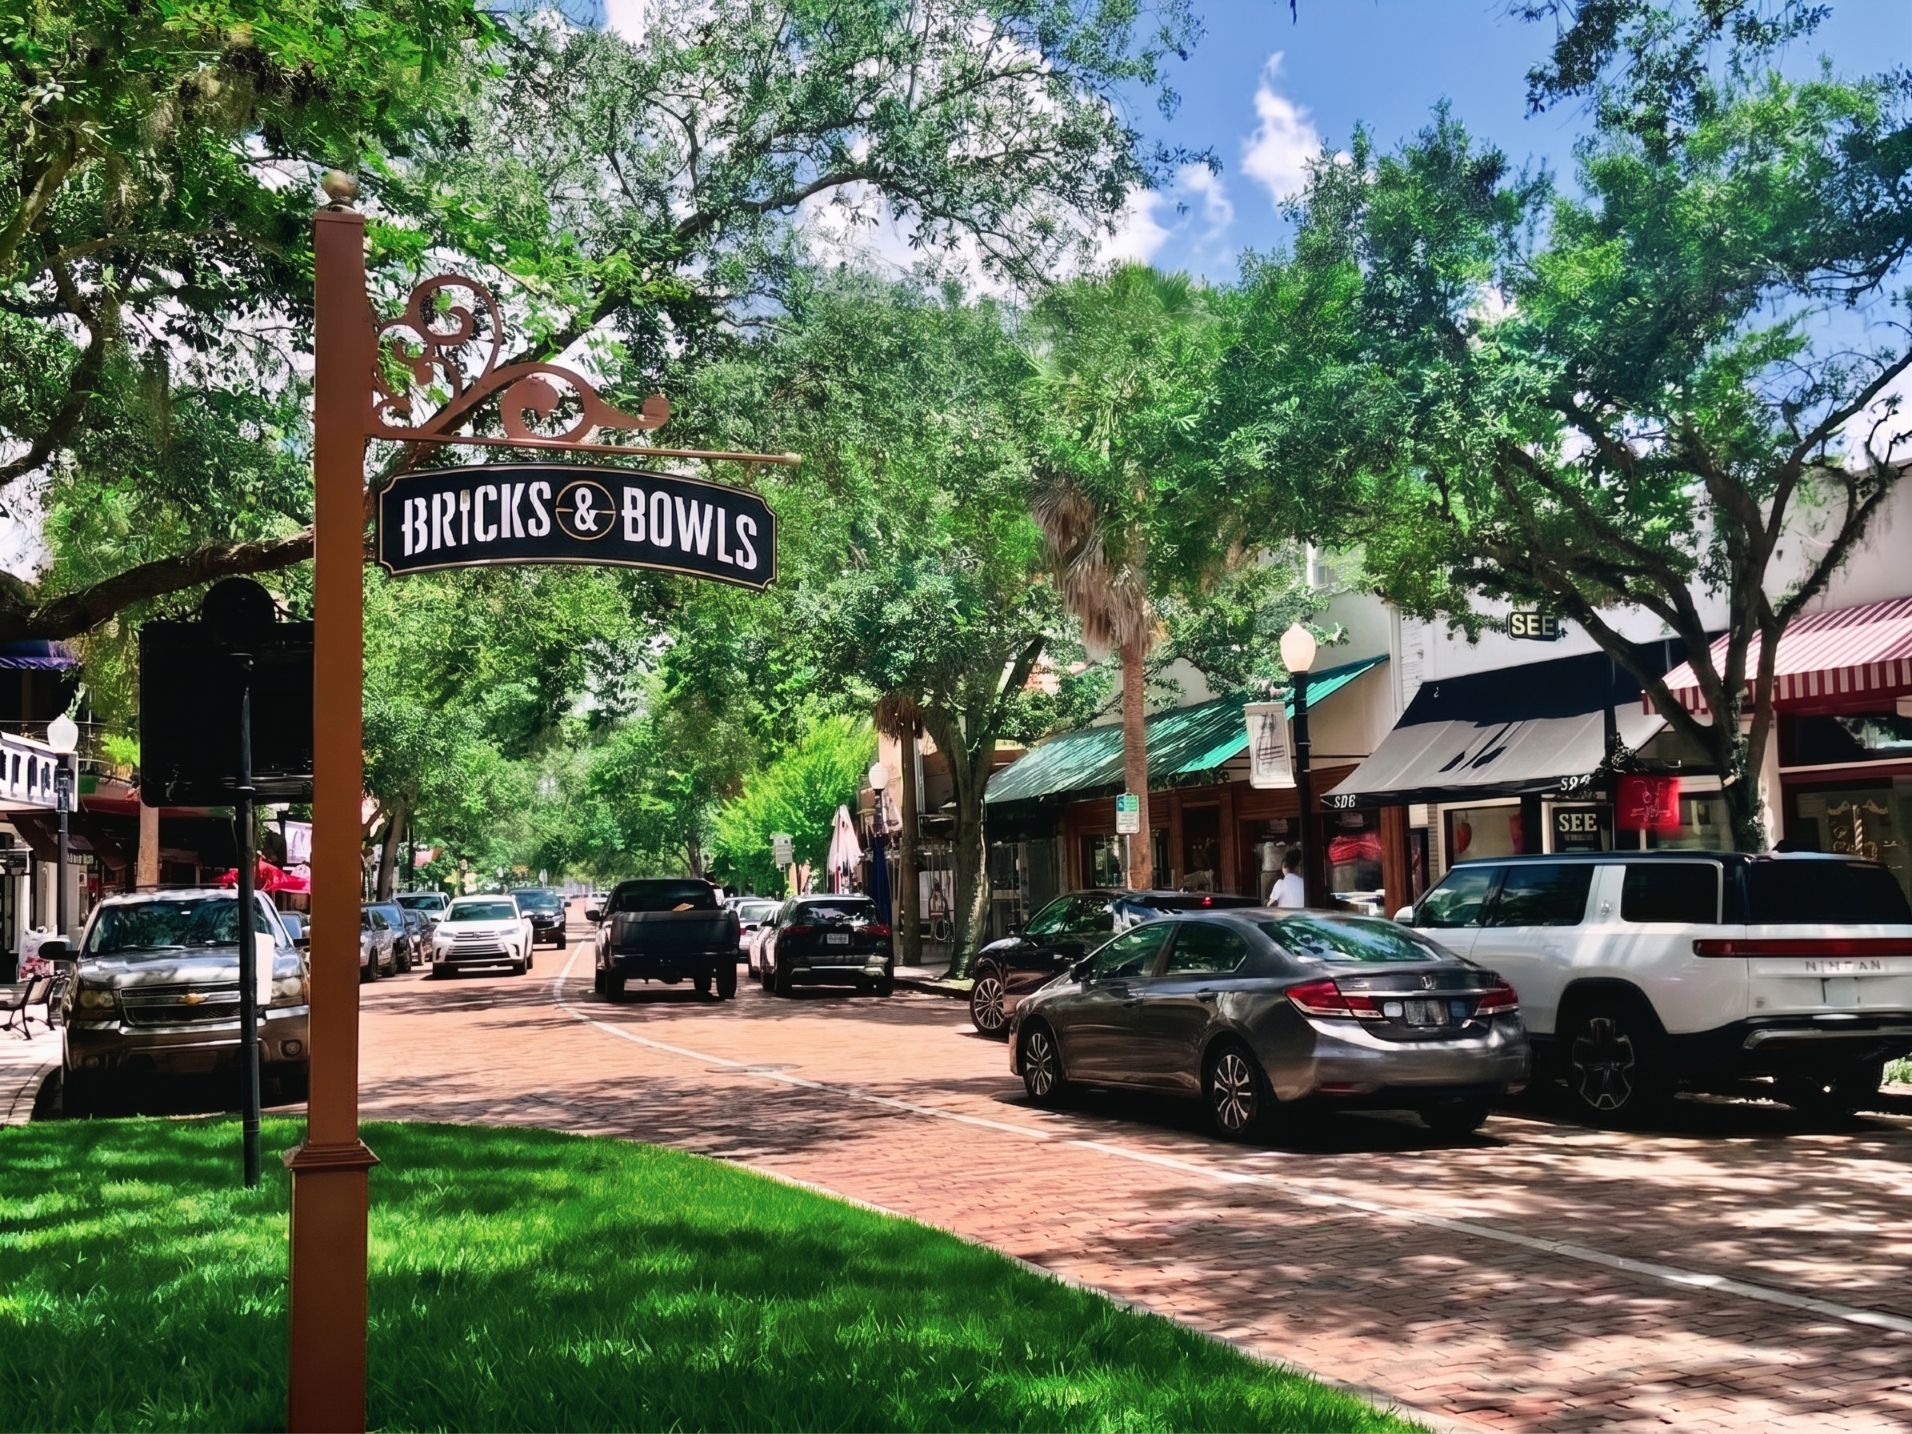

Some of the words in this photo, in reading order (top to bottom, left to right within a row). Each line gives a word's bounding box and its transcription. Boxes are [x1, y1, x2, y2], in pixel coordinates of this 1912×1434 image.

[402, 481, 552, 556] BRICKS
[574, 487, 601, 532] &
[622, 486, 759, 571] BOWLS
[1511, 613, 1555, 636] SEE
[1559, 813, 1598, 832] SEE
